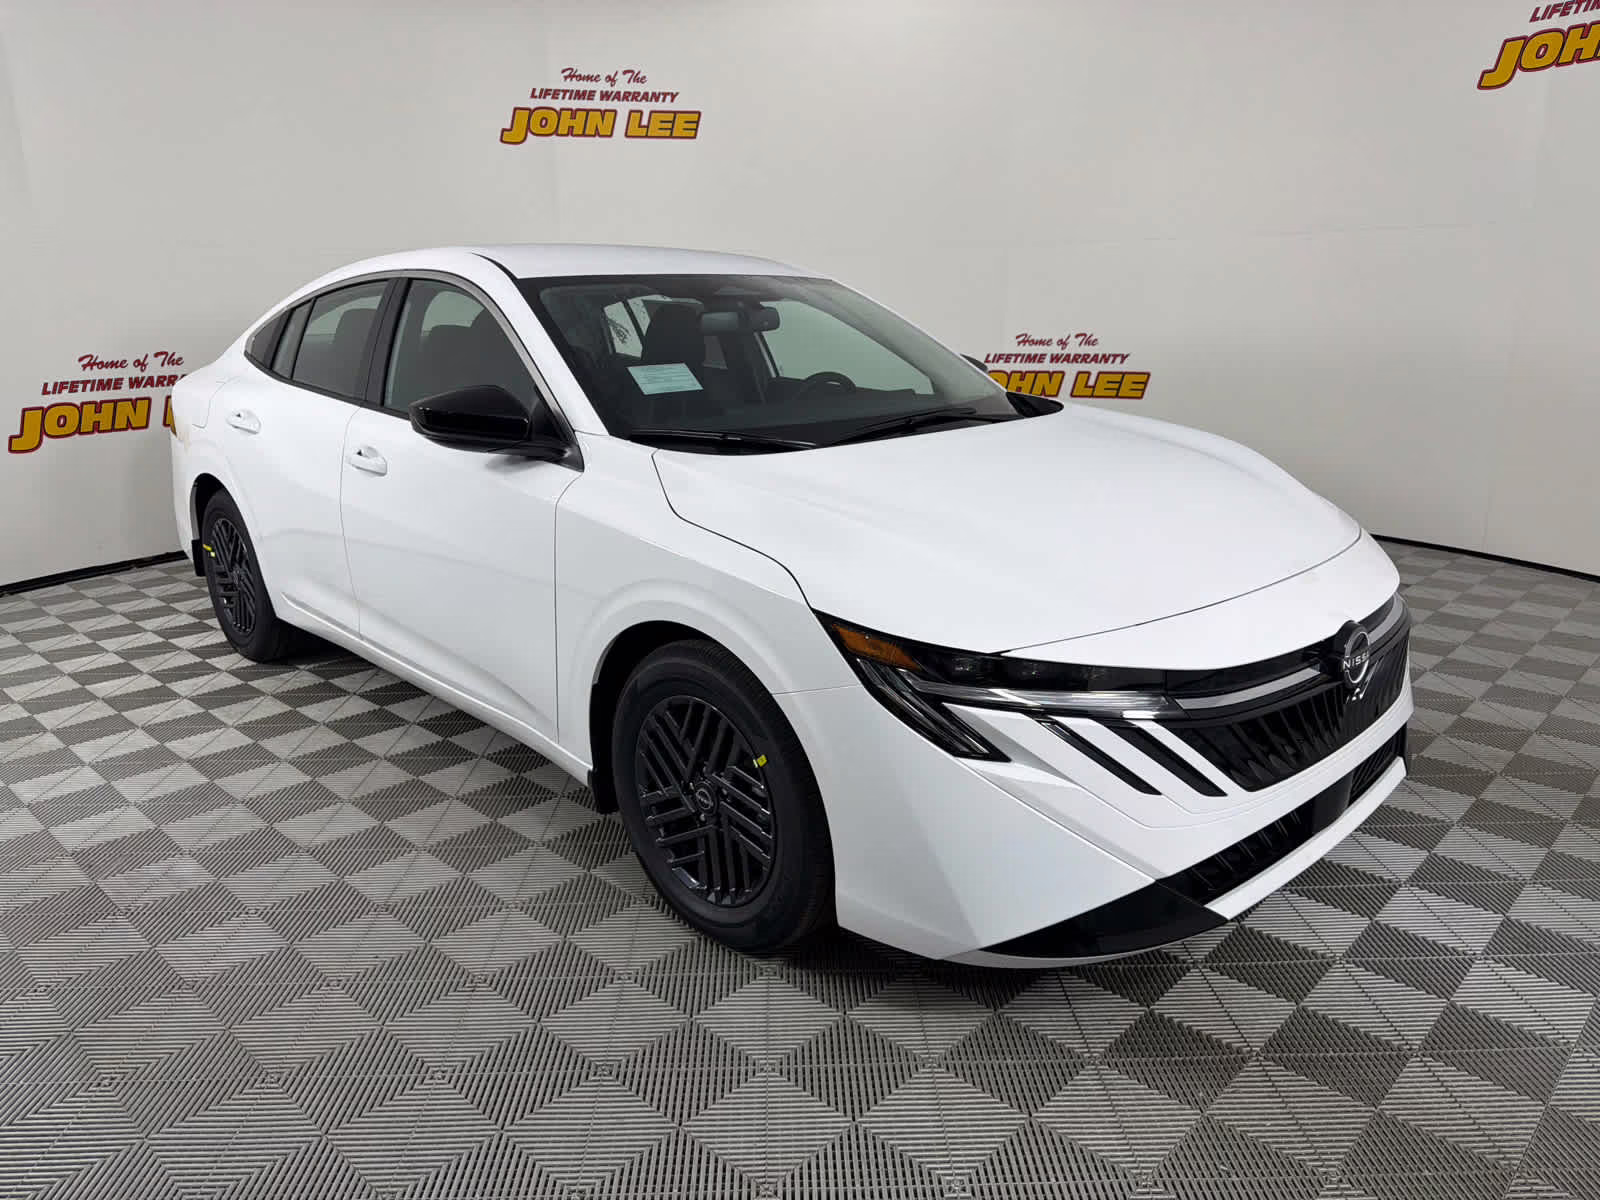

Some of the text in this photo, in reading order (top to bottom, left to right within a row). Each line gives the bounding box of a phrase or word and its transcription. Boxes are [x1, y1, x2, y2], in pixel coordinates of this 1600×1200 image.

[561, 67, 648, 87] Home of The
[530, 88, 679, 103] LIFETIME WARRANTY
[500, 106, 702, 145] JOHN LEE
[1015, 332, 1099, 350] Home of The
[78, 351, 184, 372] Home of The
[984, 353, 1130, 365] LIFETIME WARRANTY
[42, 374, 187, 396] LIFETIME WARR
[1070, 371, 1151, 399] LEE
[8, 397, 152, 453] JOHN
[1343, 650, 1369, 671] NISS
